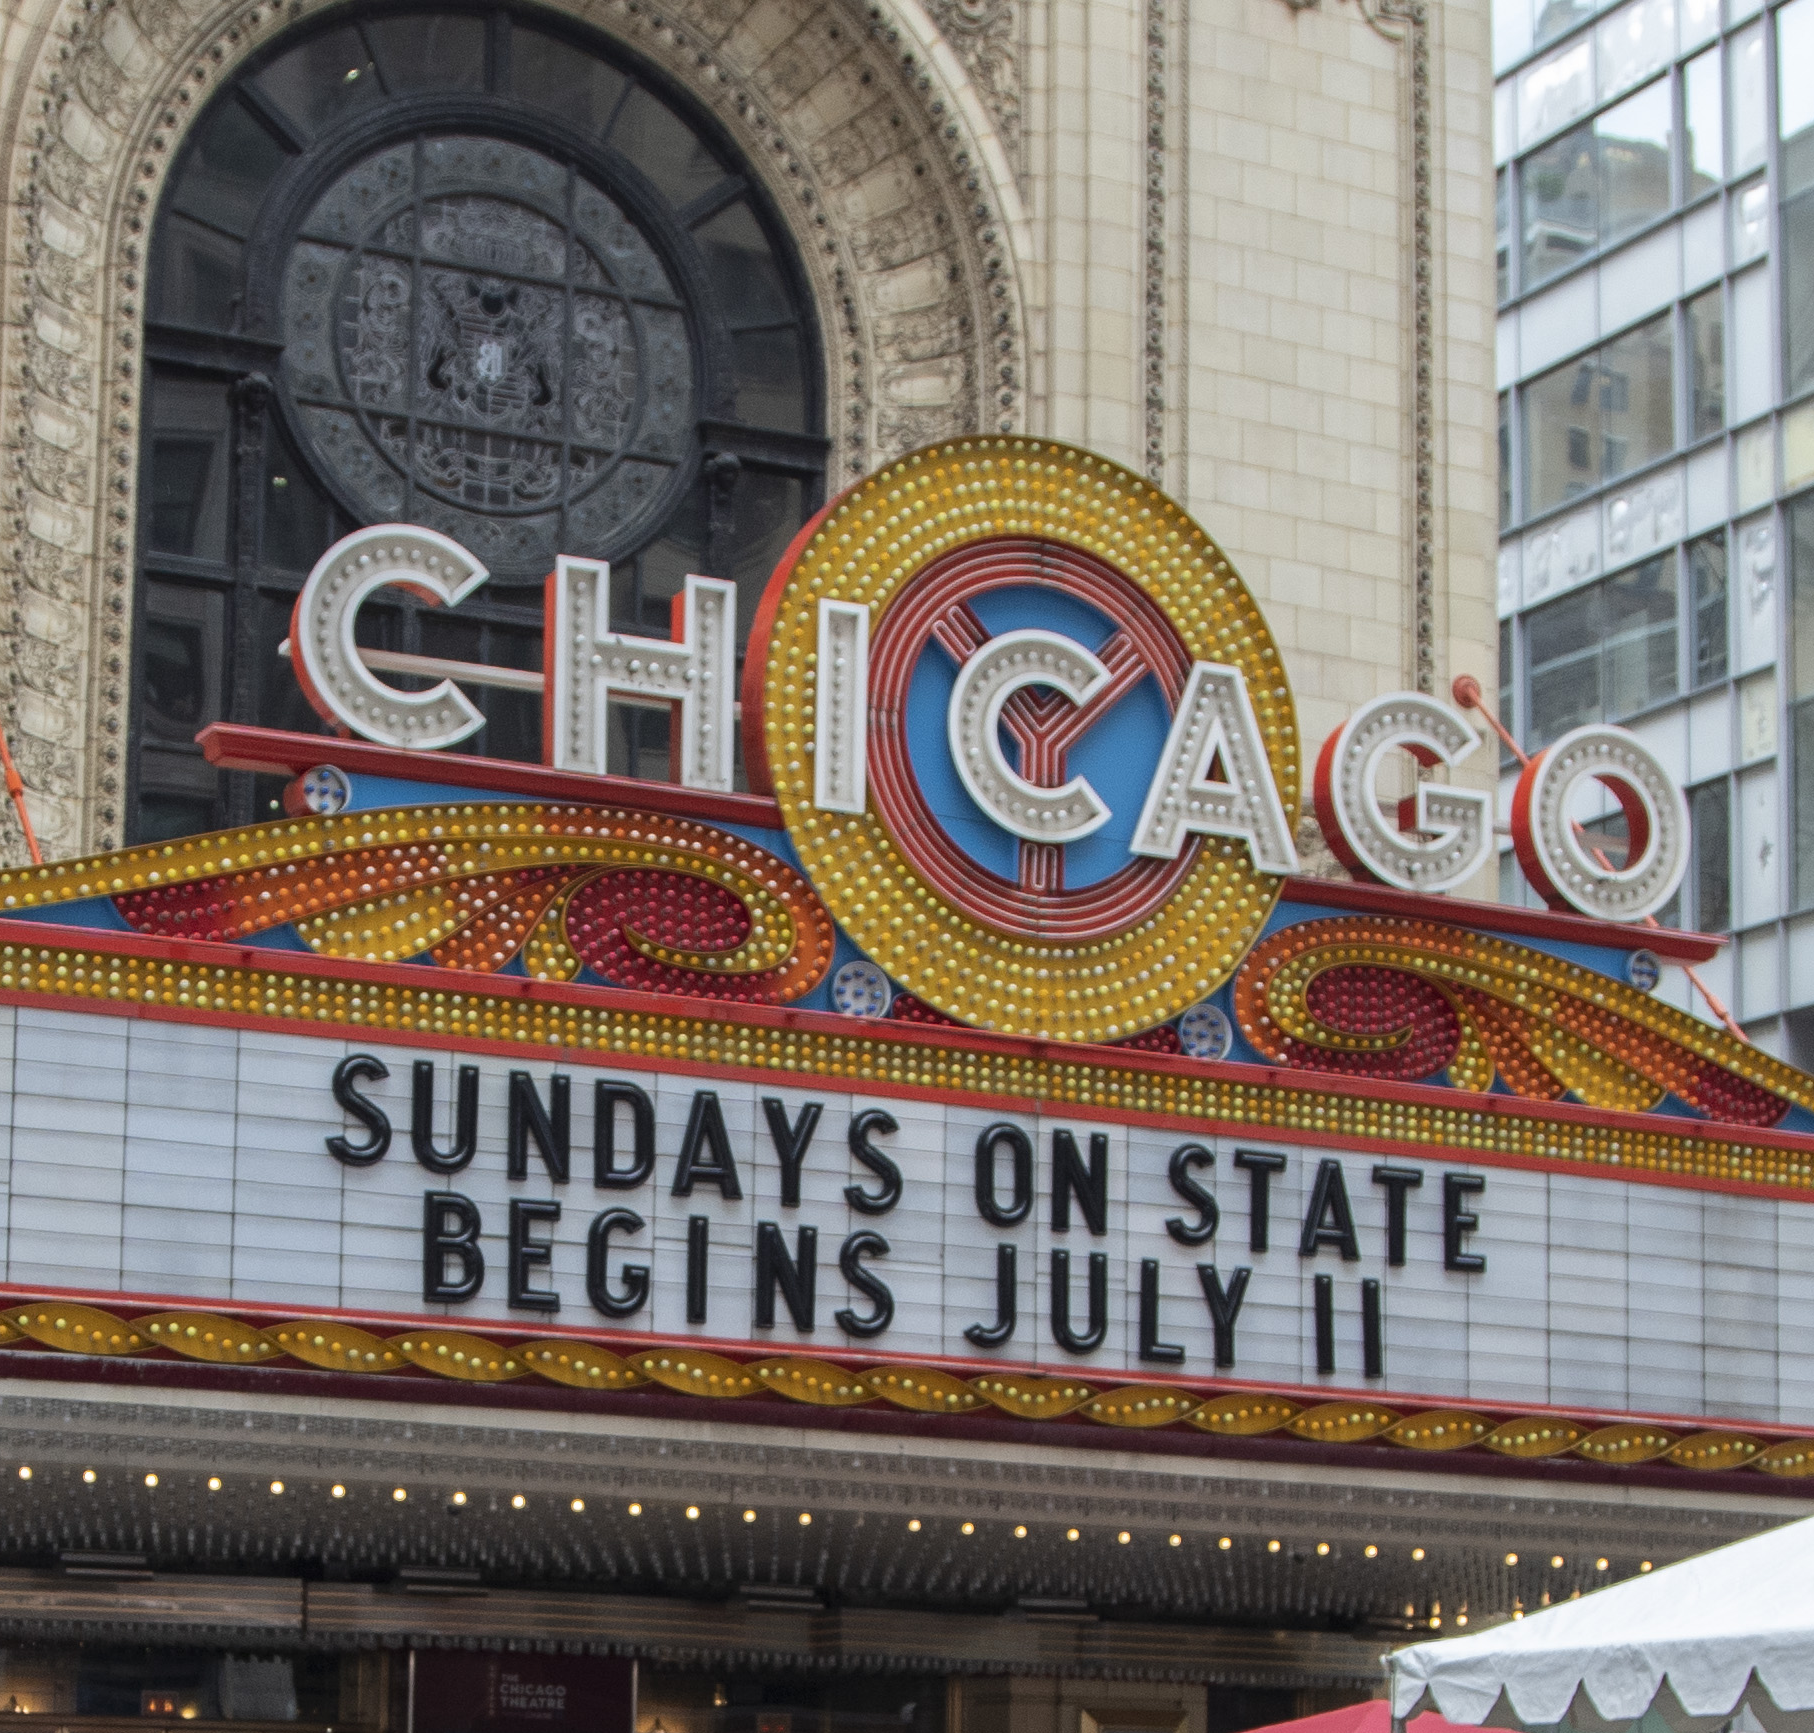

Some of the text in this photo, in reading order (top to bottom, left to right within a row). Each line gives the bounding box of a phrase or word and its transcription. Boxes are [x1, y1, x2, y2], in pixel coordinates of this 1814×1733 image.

[290, 521, 1690, 922] CHICAGO
[325, 1052, 1489, 1275] SUNDAYS ON STATE
[422, 1189, 896, 1340] BEGINS
[963, 1240, 1252, 1369] JULY
[499, 1684, 566, 1697] CHICAGO
[500, 1696, 565, 1709] THEATRE
